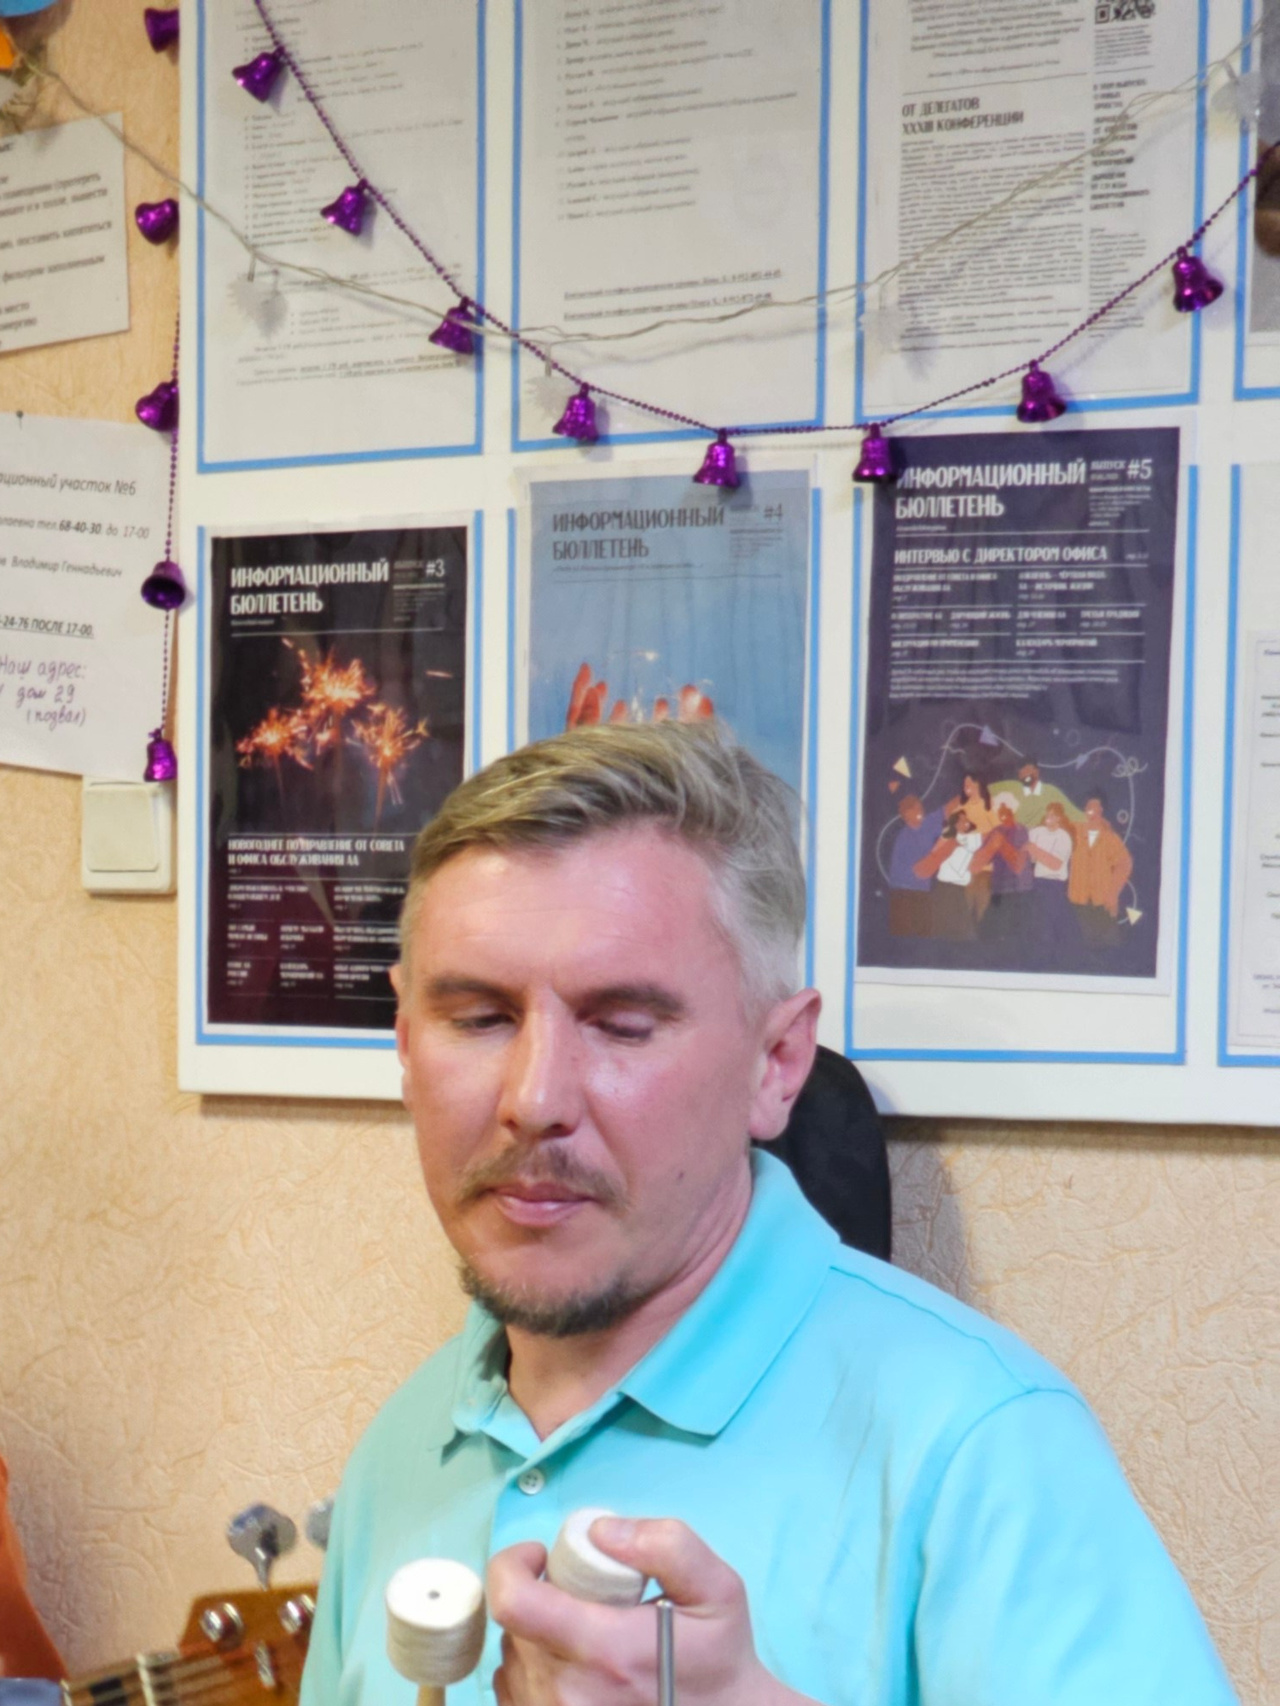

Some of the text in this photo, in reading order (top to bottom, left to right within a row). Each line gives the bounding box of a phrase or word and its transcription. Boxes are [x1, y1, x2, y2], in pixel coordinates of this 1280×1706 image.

[919, 97, 980, 117] ДЕЛЕГАТОВ
[937, 110, 1024, 131] КОНФЕРЕНЦИИ
[1128, 459, 1153, 480] #5
[59, 478, 111, 494] участок
[114, 480, 137, 496] №6
[895, 494, 1005, 520] БЮЛЛЕТЕНЬ
[552, 504, 784, 533] ИНФОРМАЦИОННЫЙ #4
[106, 523, 118, 537] до
[123, 526, 150, 540] 17-00
[553, 537, 649, 561] БЮЛЛЕТЕНЬ
[894, 547, 961, 565] ИНТЕРВЬЮ
[963, 547, 971, 562] С
[974, 546, 1060, 565] ДИРЕКТОРОМ
[1062, 545, 1108, 562] ОФИСА
[12, 556, 59, 573] Владимир
[61, 561, 122, 578] Геннадьевич
[230, 558, 390, 589] ИНФОРМАЦИОННЫЙ
[426, 559, 446, 578] #3
[231, 592, 323, 615] БЮЛЛЕТЕНЬ
[31, 619, 63, 633] ПОСЛЕ
[370, 839, 405, 852] СОВЕТА
